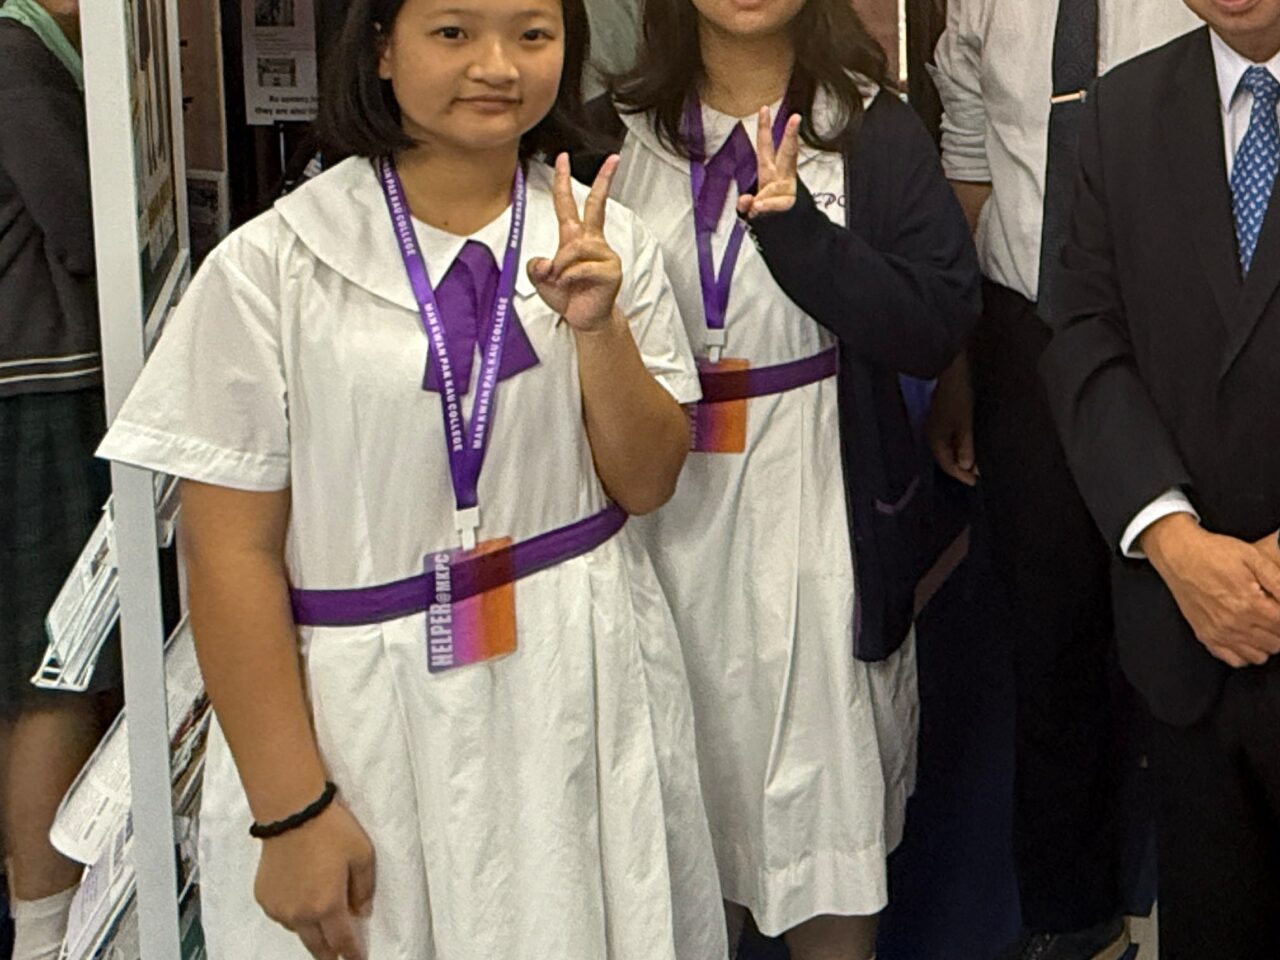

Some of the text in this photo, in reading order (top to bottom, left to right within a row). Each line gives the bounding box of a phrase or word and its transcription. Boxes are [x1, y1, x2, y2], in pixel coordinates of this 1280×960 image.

[395, 214, 417, 257] COLLEGE
[424, 303, 464, 453] MAN KWAN PAK KAU COLLEGE
[472, 297, 509, 450] MAN KWAN PAK KAU COLLEGE
